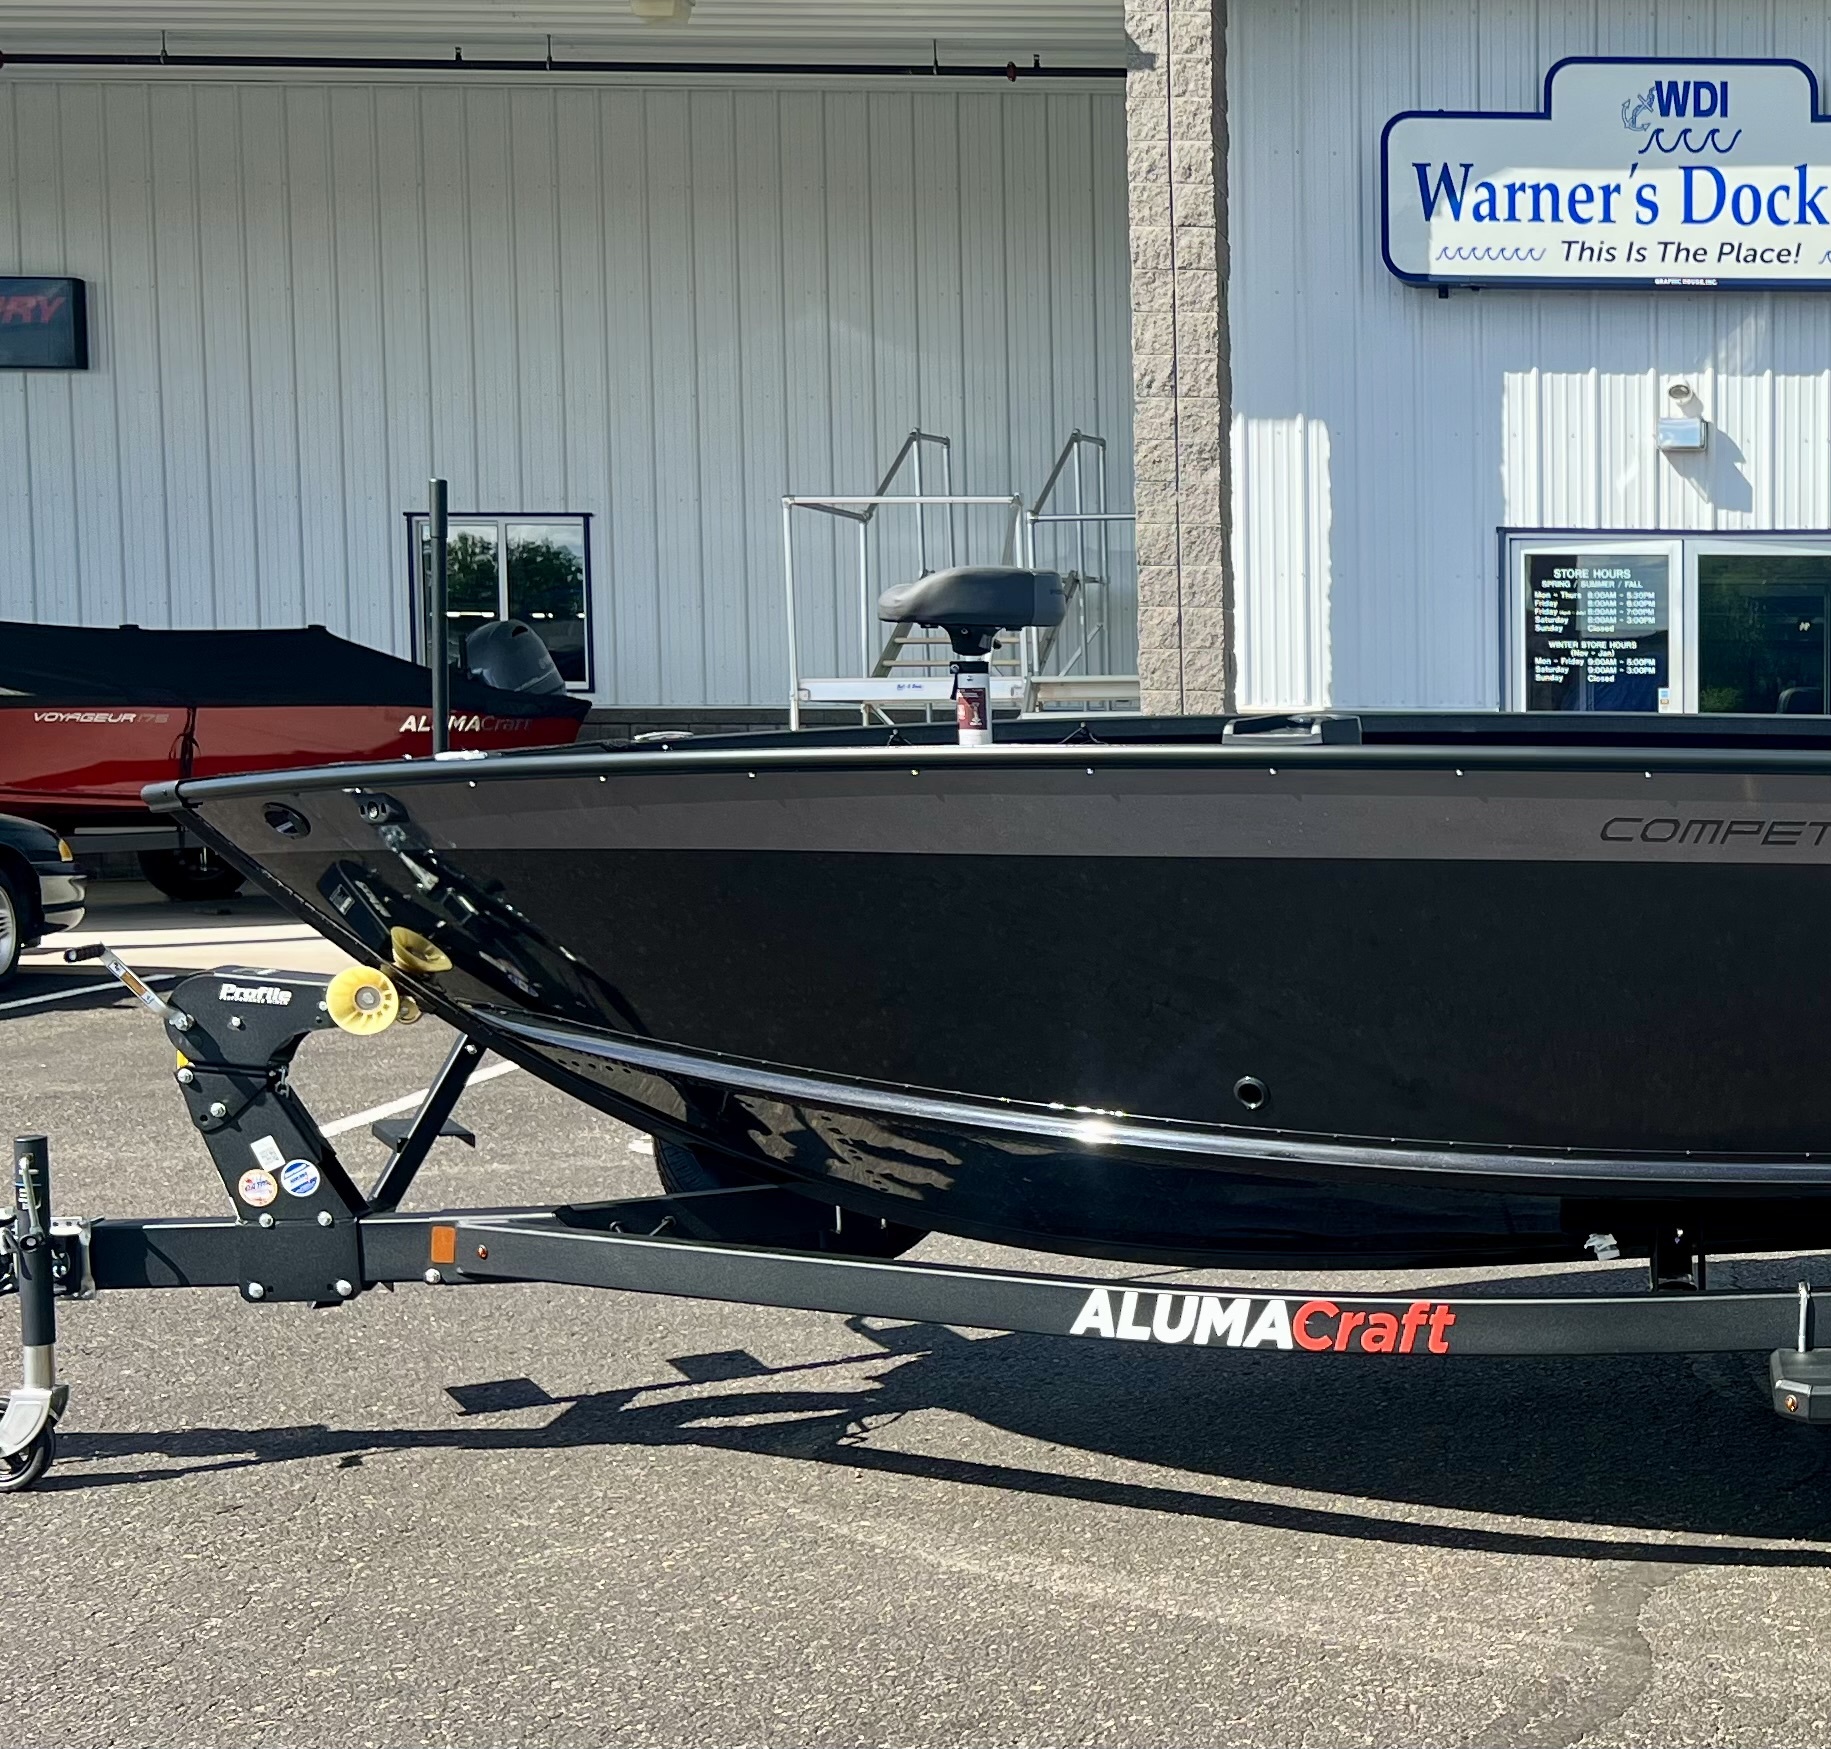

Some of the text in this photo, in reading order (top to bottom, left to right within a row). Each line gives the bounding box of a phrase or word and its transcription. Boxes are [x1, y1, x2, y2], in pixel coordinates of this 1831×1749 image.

[1655, 81, 1728, 117] WDI
[1412, 162, 1659, 226] Warner's
[1681, 164, 1829, 228] Dock
[1561, 241, 1802, 266] This Is The Place!
[1553, 568, 1631, 579] STORE HOURS
[1541, 580, 1571, 588] SPRING
[1580, 580, 1615, 588] SUMMER
[1624, 580, 1643, 588] FALL
[1534, 616, 1569, 624] Saturday
[1534, 625, 1563, 633] Sunday
[1548, 640, 1637, 649] WINTER STORE HOURS
[1534, 657, 1551, 666] Mon
[1560, 657, 1584, 666] Friday
[1535, 666, 1569, 674] Saturday
[1535, 675, 1563, 683] Sunday
[34, 712, 137, 723] VOYAGEUR
[399, 715, 534, 733] ALMACraft
[220, 983, 292, 1001] Profile
[1070, 1288, 1457, 1353] ALUMACraft
